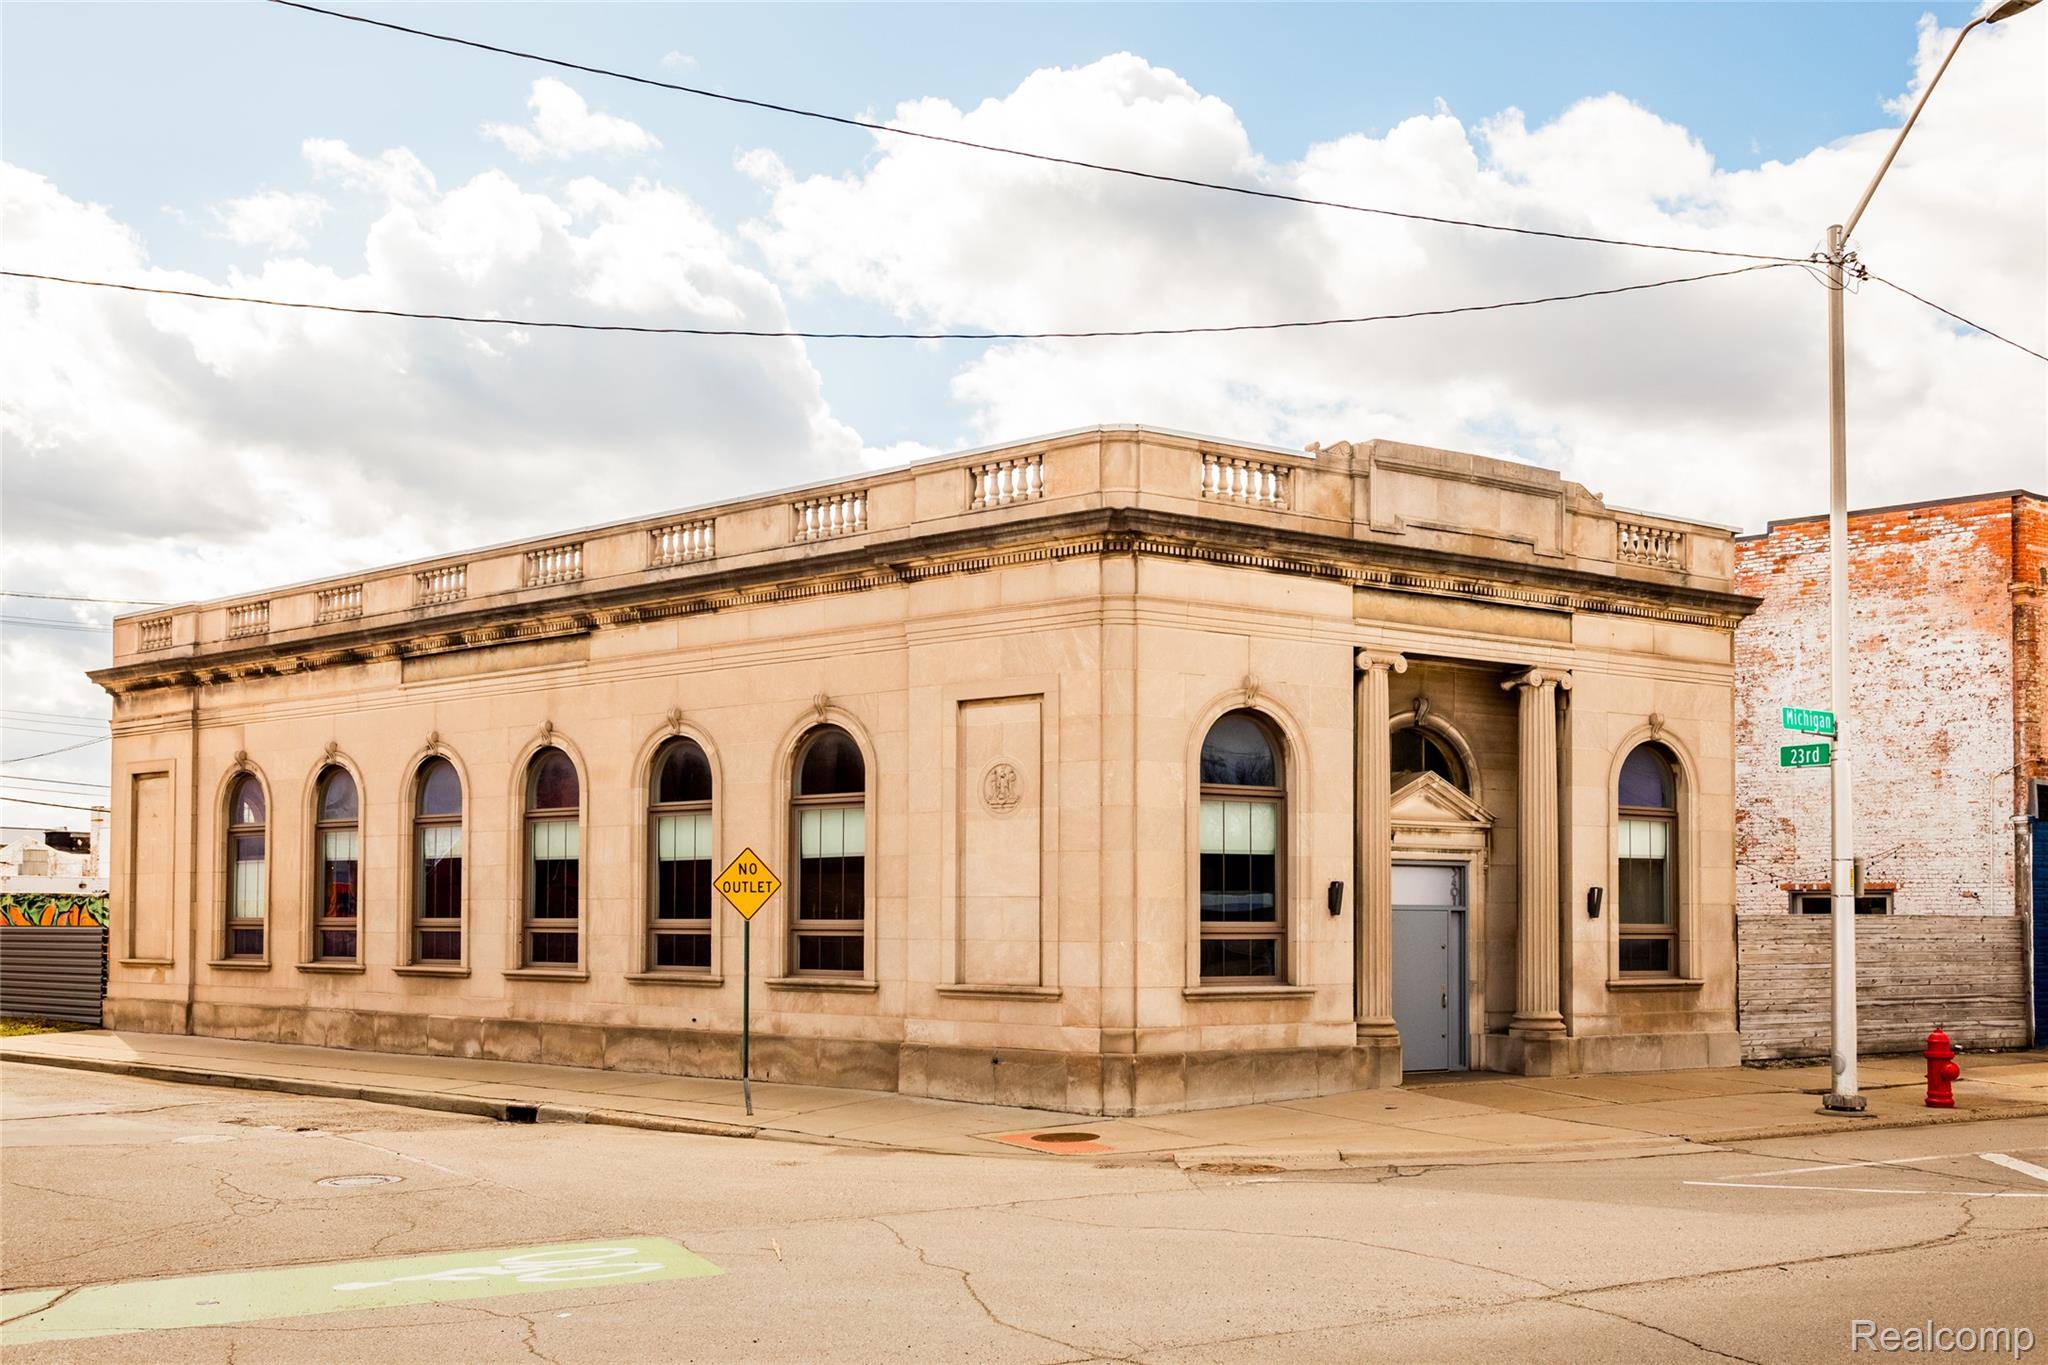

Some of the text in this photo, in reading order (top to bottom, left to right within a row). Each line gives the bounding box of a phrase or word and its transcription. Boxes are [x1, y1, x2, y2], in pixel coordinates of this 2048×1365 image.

[1786, 709, 1831, 732] Michigan
[1790, 746, 1820, 764] 23rd
[738, 863, 757, 875] NO
[722, 881, 772, 893] OUTLET
